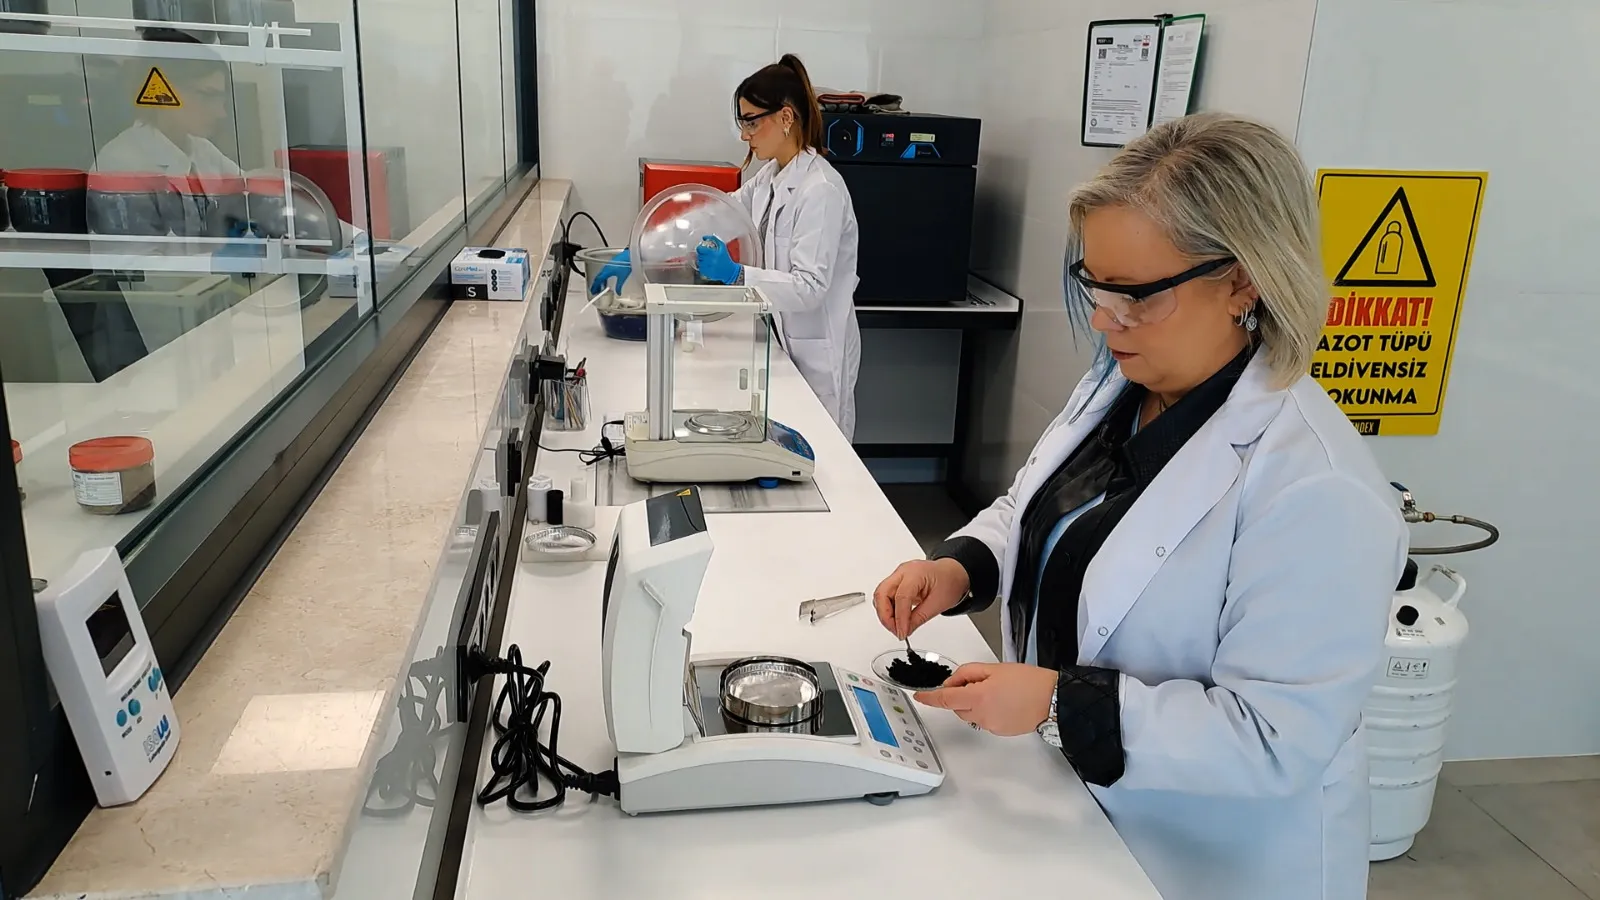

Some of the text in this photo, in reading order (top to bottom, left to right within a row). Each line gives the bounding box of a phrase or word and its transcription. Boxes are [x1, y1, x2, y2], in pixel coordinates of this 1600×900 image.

[467, 286, 477, 297] S
[1326, 291, 1433, 326] DİKKAT!
[1316, 331, 1432, 351] AZOT TÜPÜ
[1310, 357, 1428, 378] ELDİVENSİZ
[1327, 388, 1418, 405] OKUNMA
